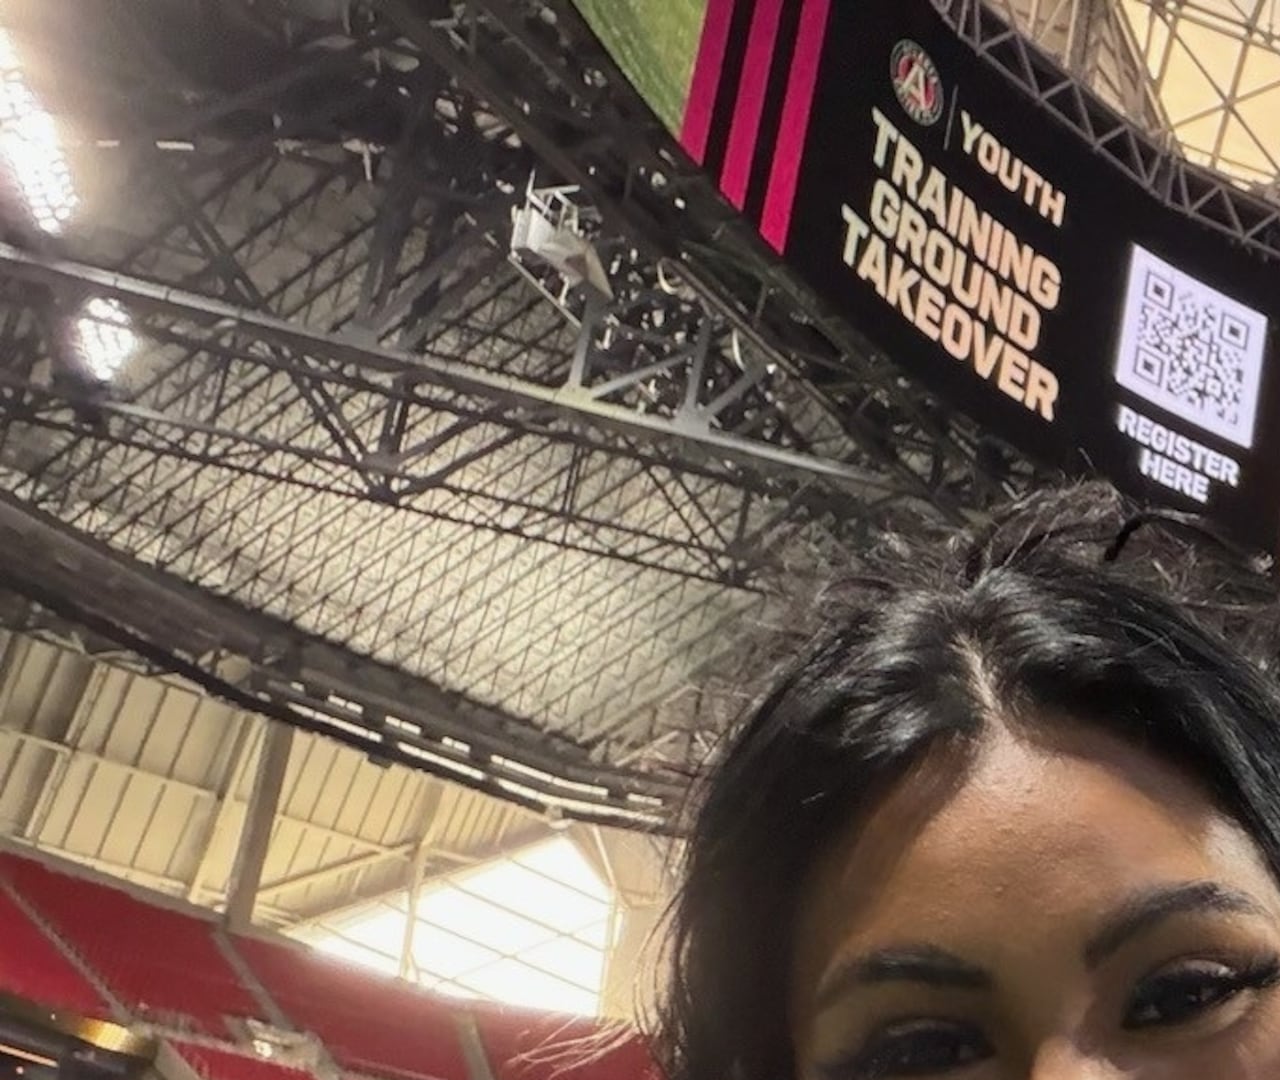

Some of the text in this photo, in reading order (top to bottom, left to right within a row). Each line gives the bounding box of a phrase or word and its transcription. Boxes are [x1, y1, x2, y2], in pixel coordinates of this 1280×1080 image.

[871, 106, 1062, 311] TRAINING
[956, 110, 1066, 227] YOUTH
[841, 204, 1059, 421] TAKEOVER
[869, 178, 1041, 352] GROUND
[1116, 406, 1240, 489] REGISTER
[1139, 451, 1211, 503] HERE
